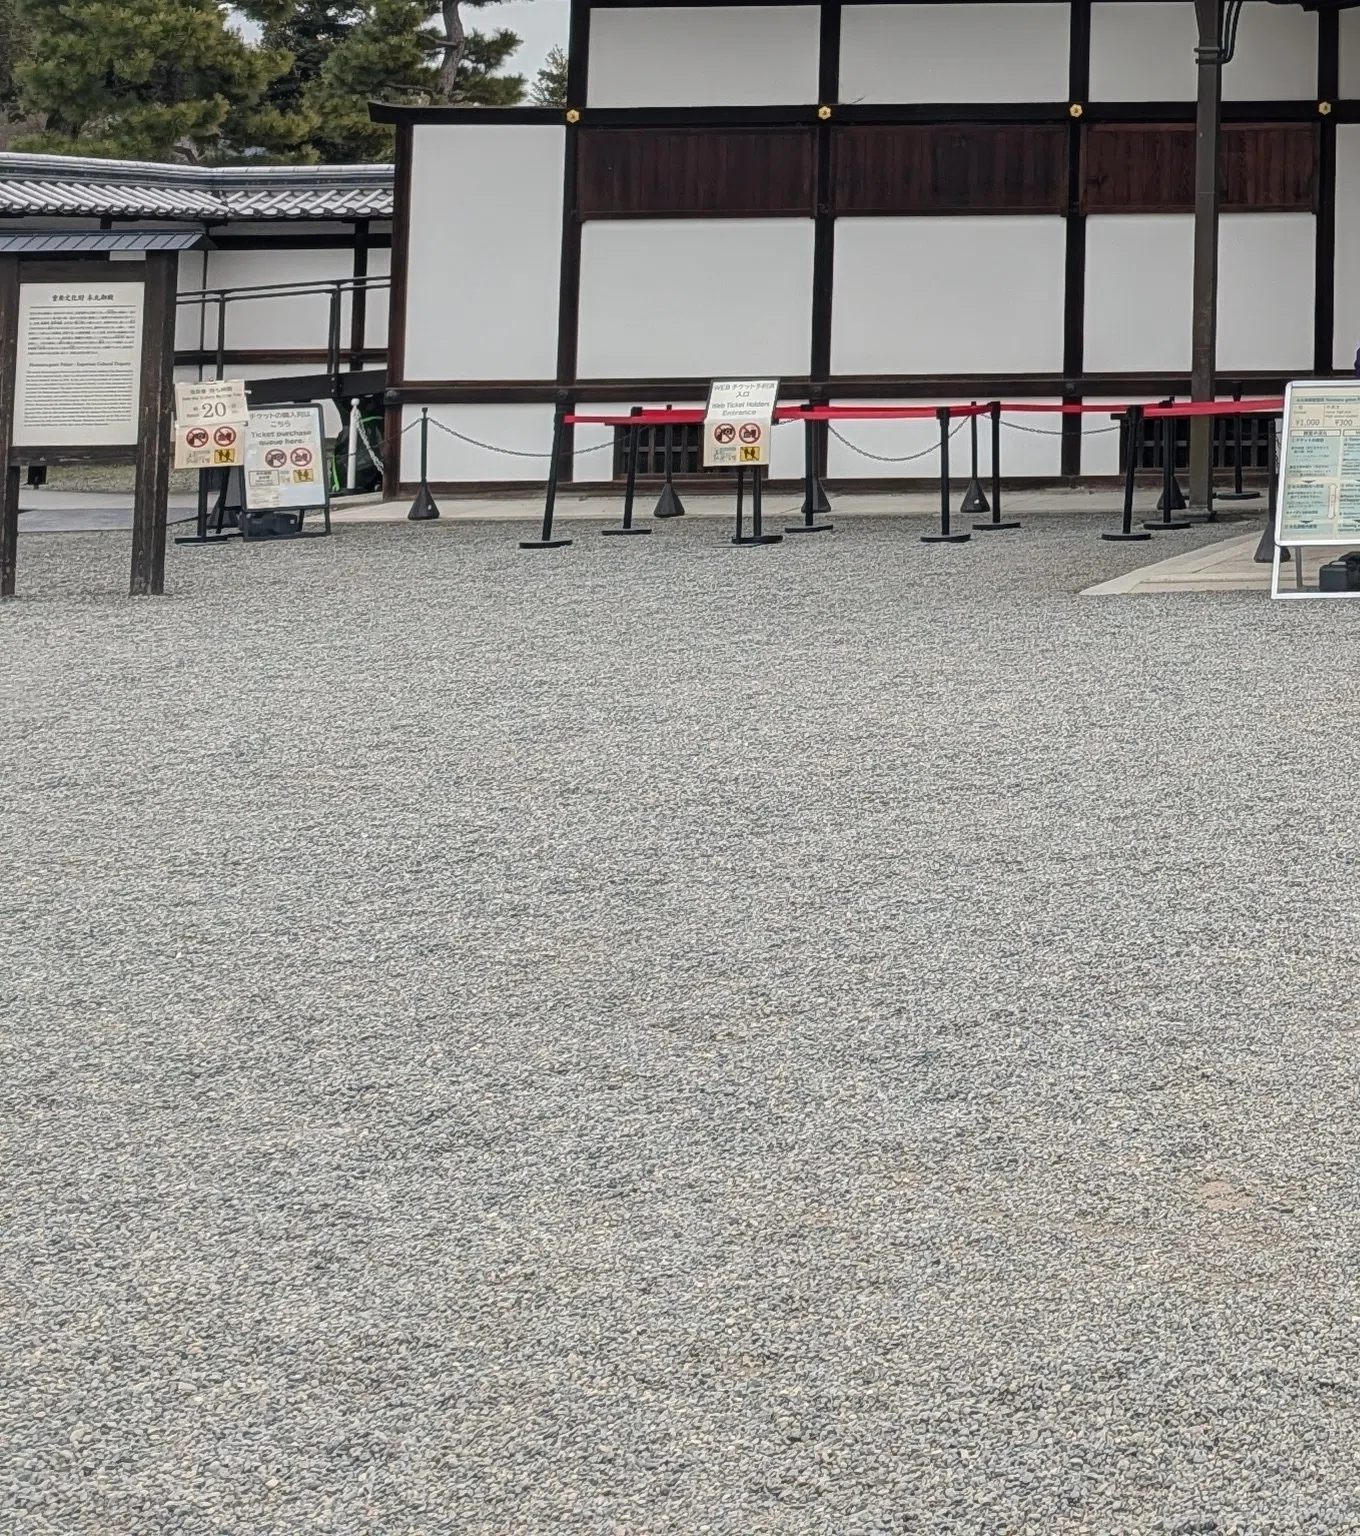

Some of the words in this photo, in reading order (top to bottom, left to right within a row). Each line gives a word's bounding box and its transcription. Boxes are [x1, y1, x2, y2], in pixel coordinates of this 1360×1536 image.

[201, 402, 227, 418] 20
[270, 420, 291, 428] こちら
